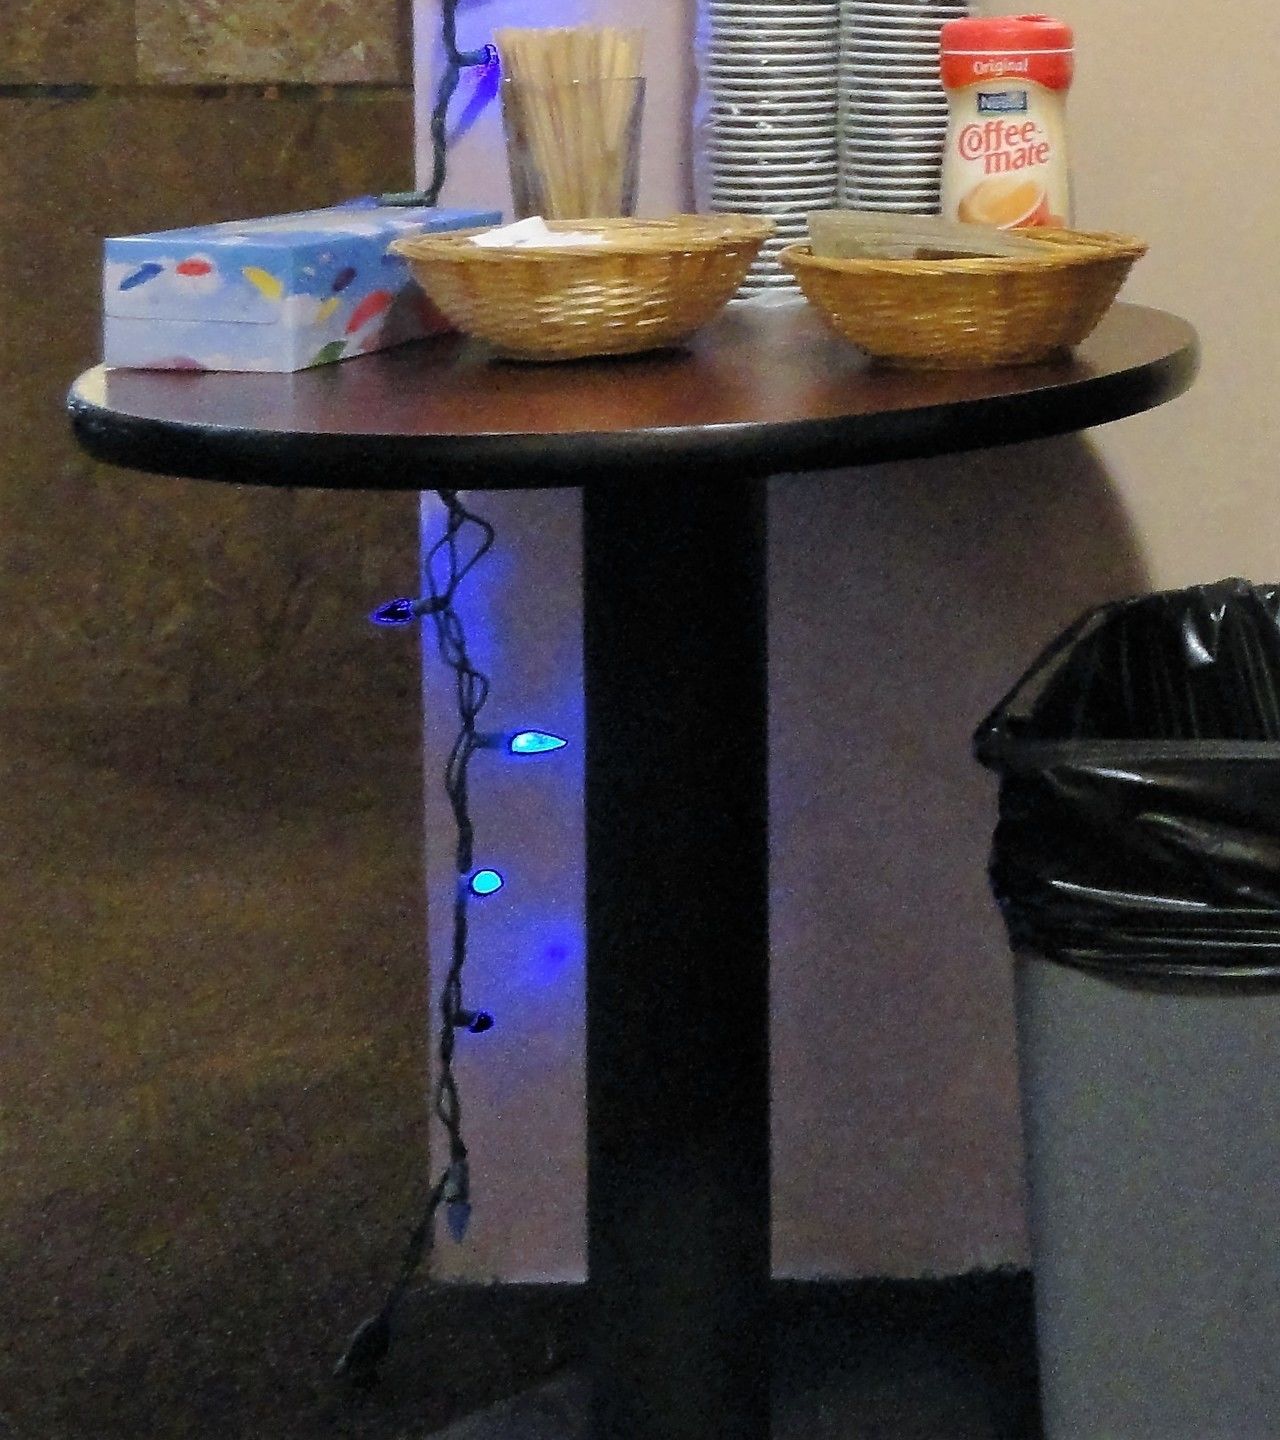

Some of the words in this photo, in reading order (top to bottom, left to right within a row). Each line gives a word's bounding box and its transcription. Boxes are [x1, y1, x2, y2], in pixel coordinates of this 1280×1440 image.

[972, 57, 1029, 77] Original
[958, 119, 1037, 162] Coffee
[984, 140, 1050, 176] mate
